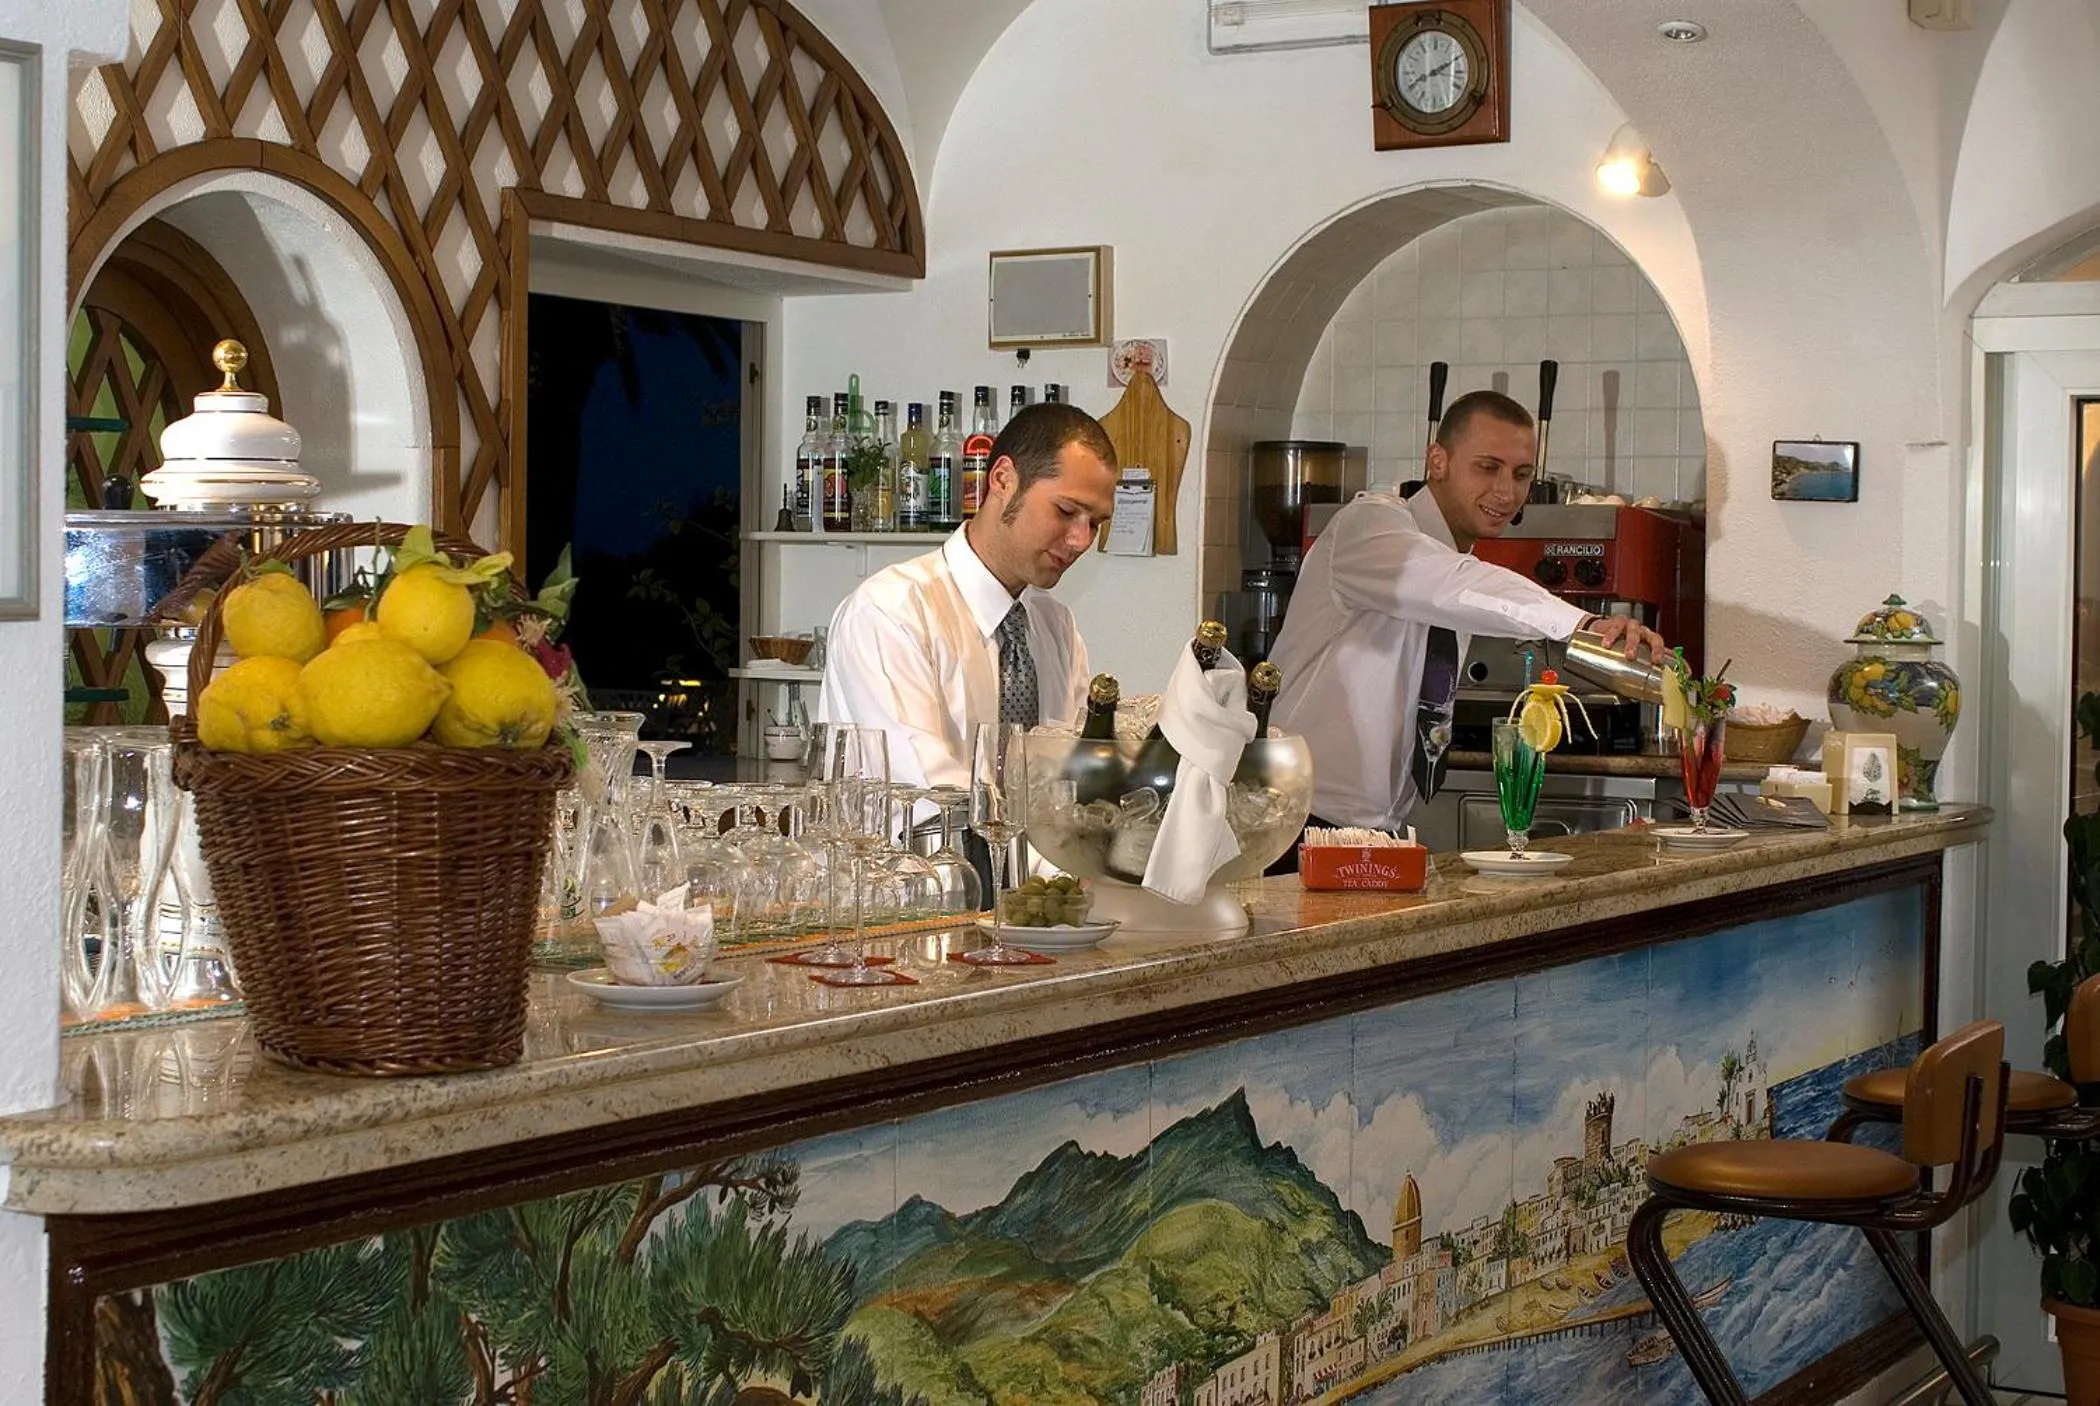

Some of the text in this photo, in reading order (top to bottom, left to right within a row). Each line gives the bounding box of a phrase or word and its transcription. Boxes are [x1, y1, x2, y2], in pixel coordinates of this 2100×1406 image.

[1556, 545, 1601, 555] RANCILIO
[1336, 863, 1397, 879] TWININGS
[1342, 879, 1387, 888] TEA CADDY
